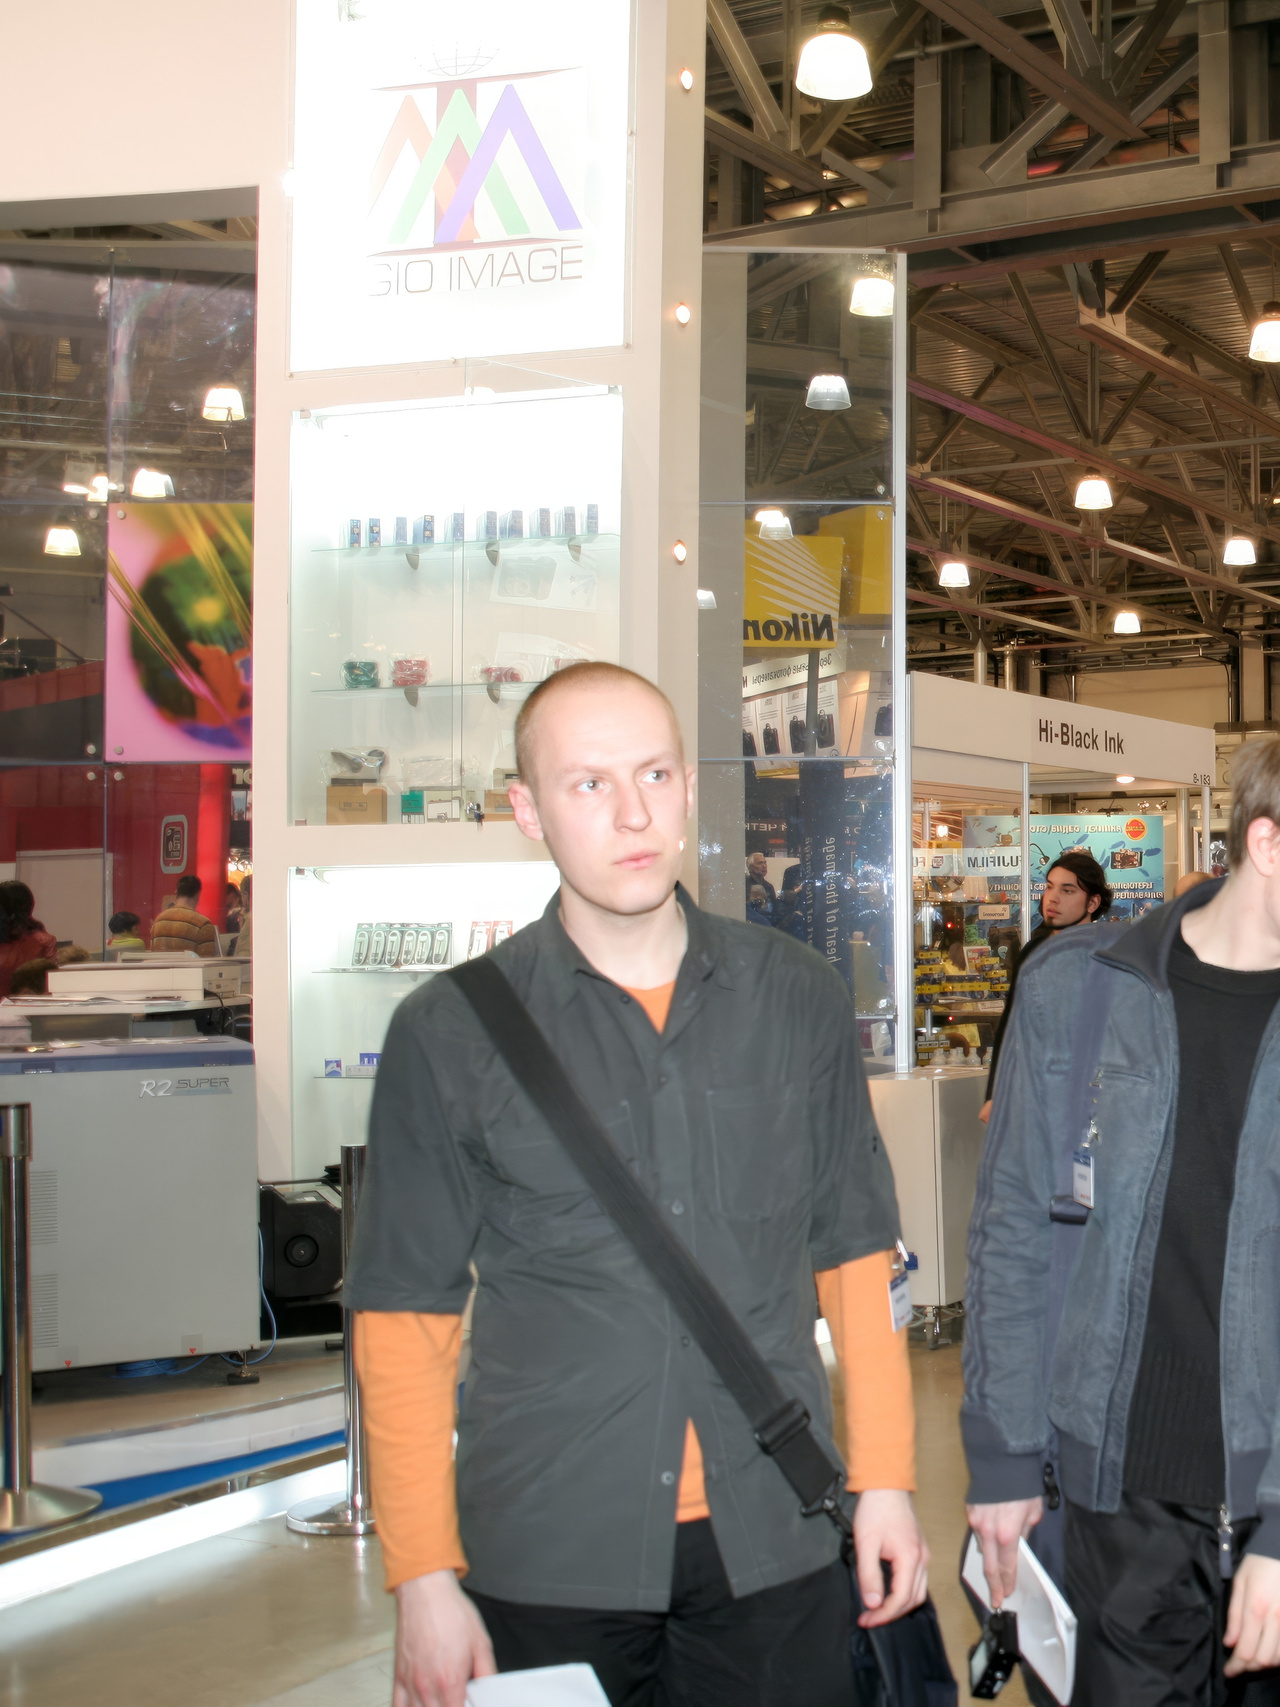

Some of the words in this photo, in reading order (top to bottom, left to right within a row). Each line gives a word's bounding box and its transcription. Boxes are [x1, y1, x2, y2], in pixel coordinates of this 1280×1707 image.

[450, 245, 583, 292] IMAGE
[1038, 718, 1099, 750] Hi-Black
[1104, 730, 1125, 754] Ink
[139, 1079, 172, 1098] R2
[175, 1077, 230, 1089] SUPER
